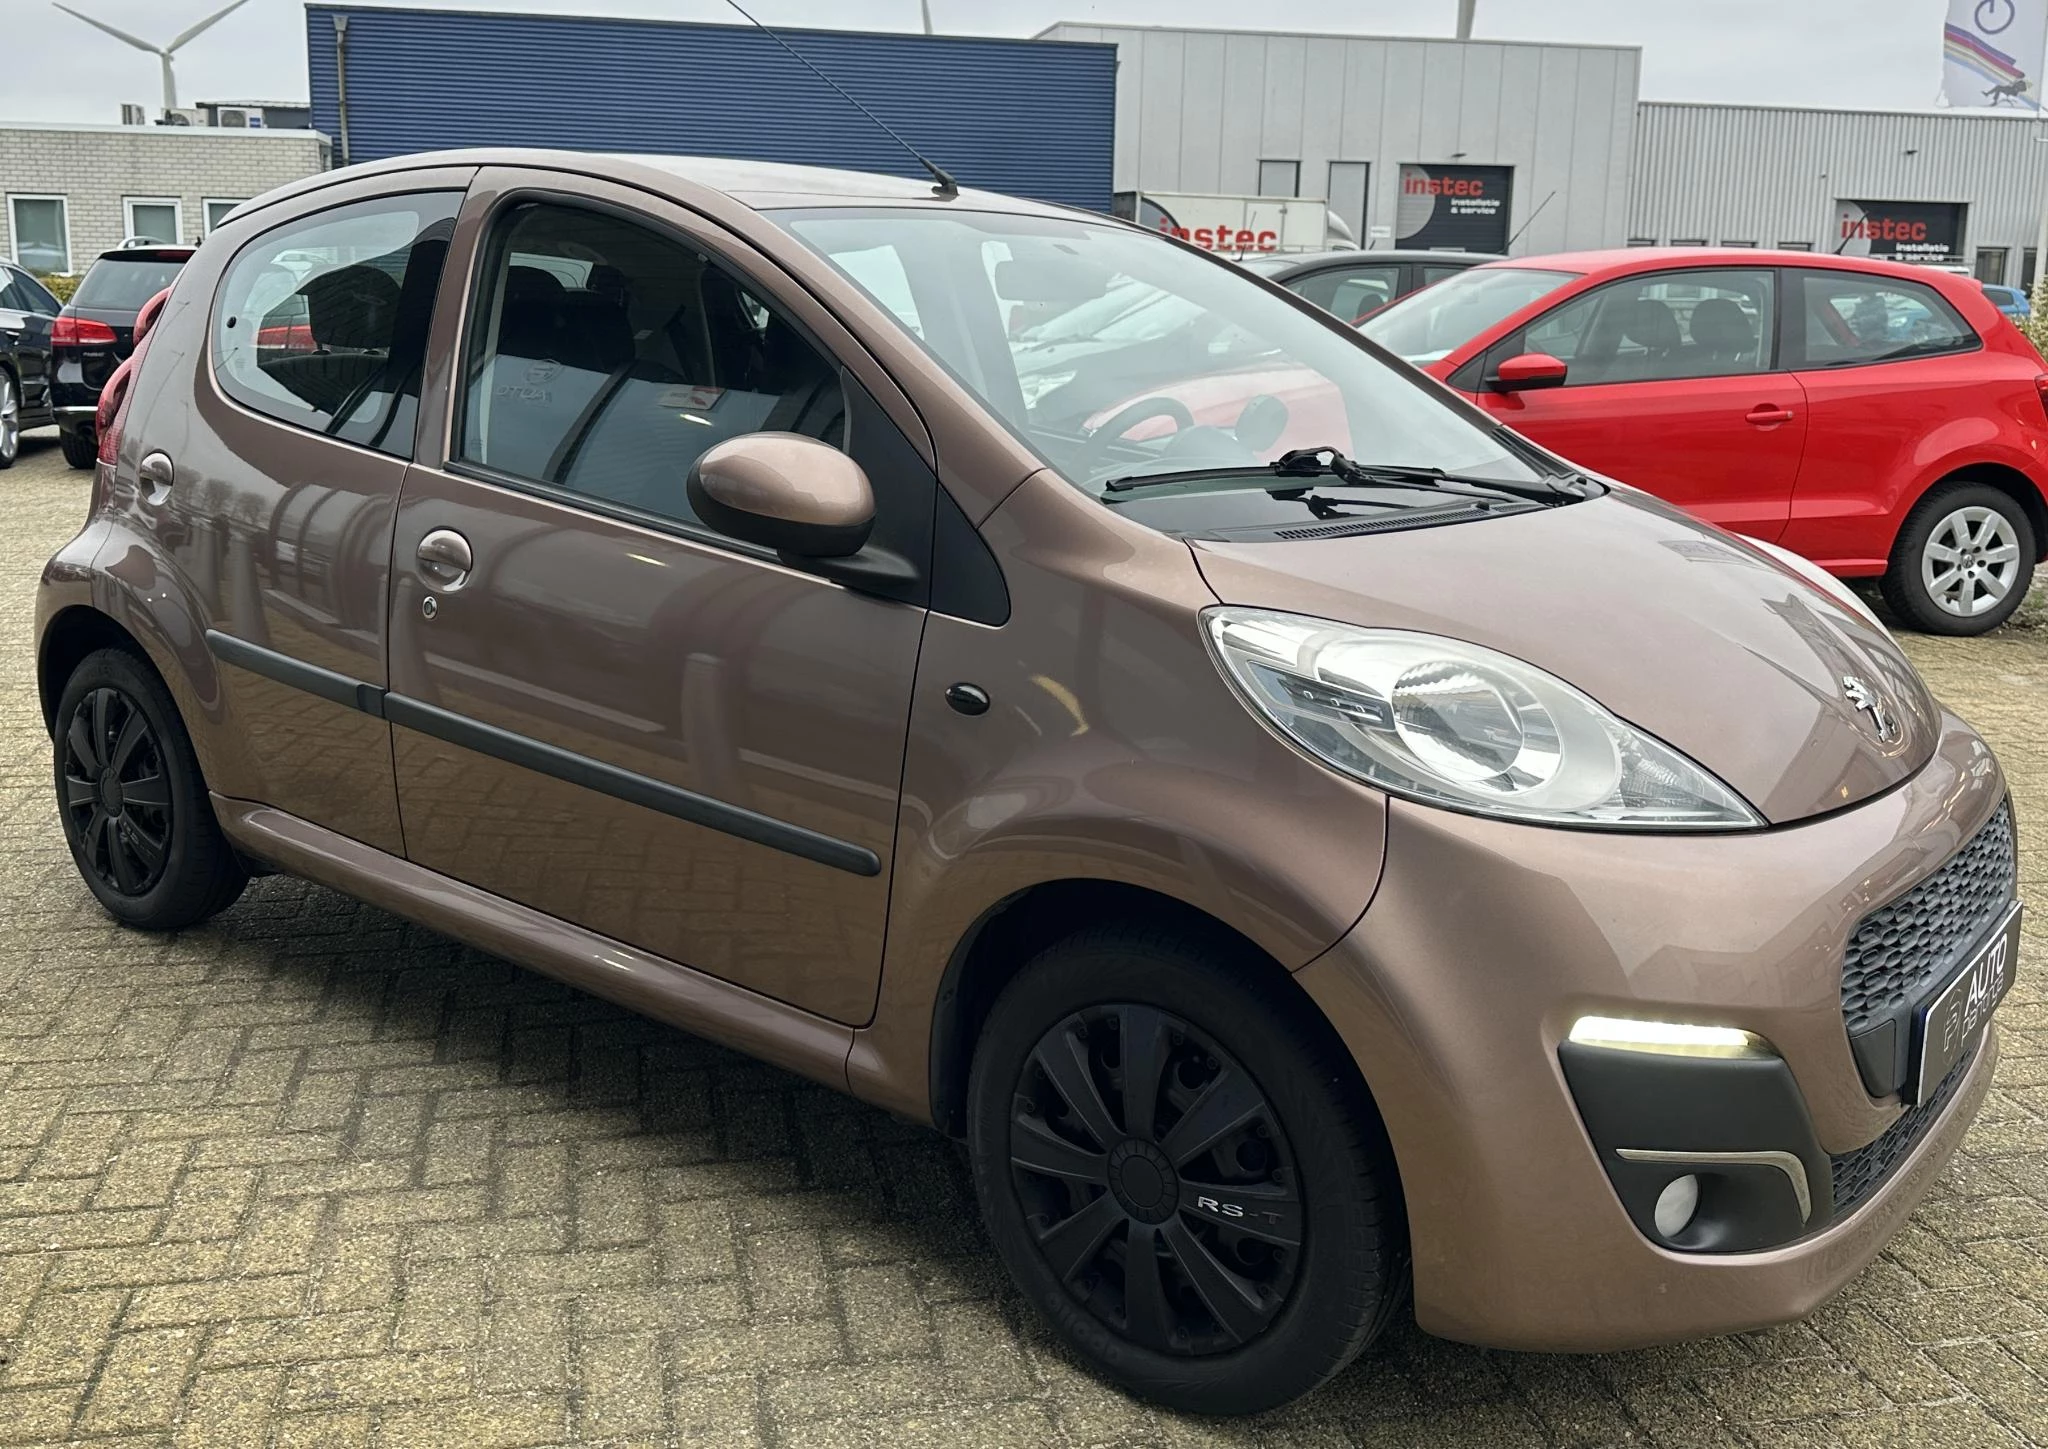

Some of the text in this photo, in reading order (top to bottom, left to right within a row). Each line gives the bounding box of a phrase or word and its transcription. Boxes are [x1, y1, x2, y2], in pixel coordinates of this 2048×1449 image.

[1404, 172, 1484, 197] instec
[1460, 207, 1496, 215] service
[1841, 214, 1927, 241] instec
[1964, 933, 2008, 1017] AUTO
[1197, 1195, 1284, 1225] RS-T
